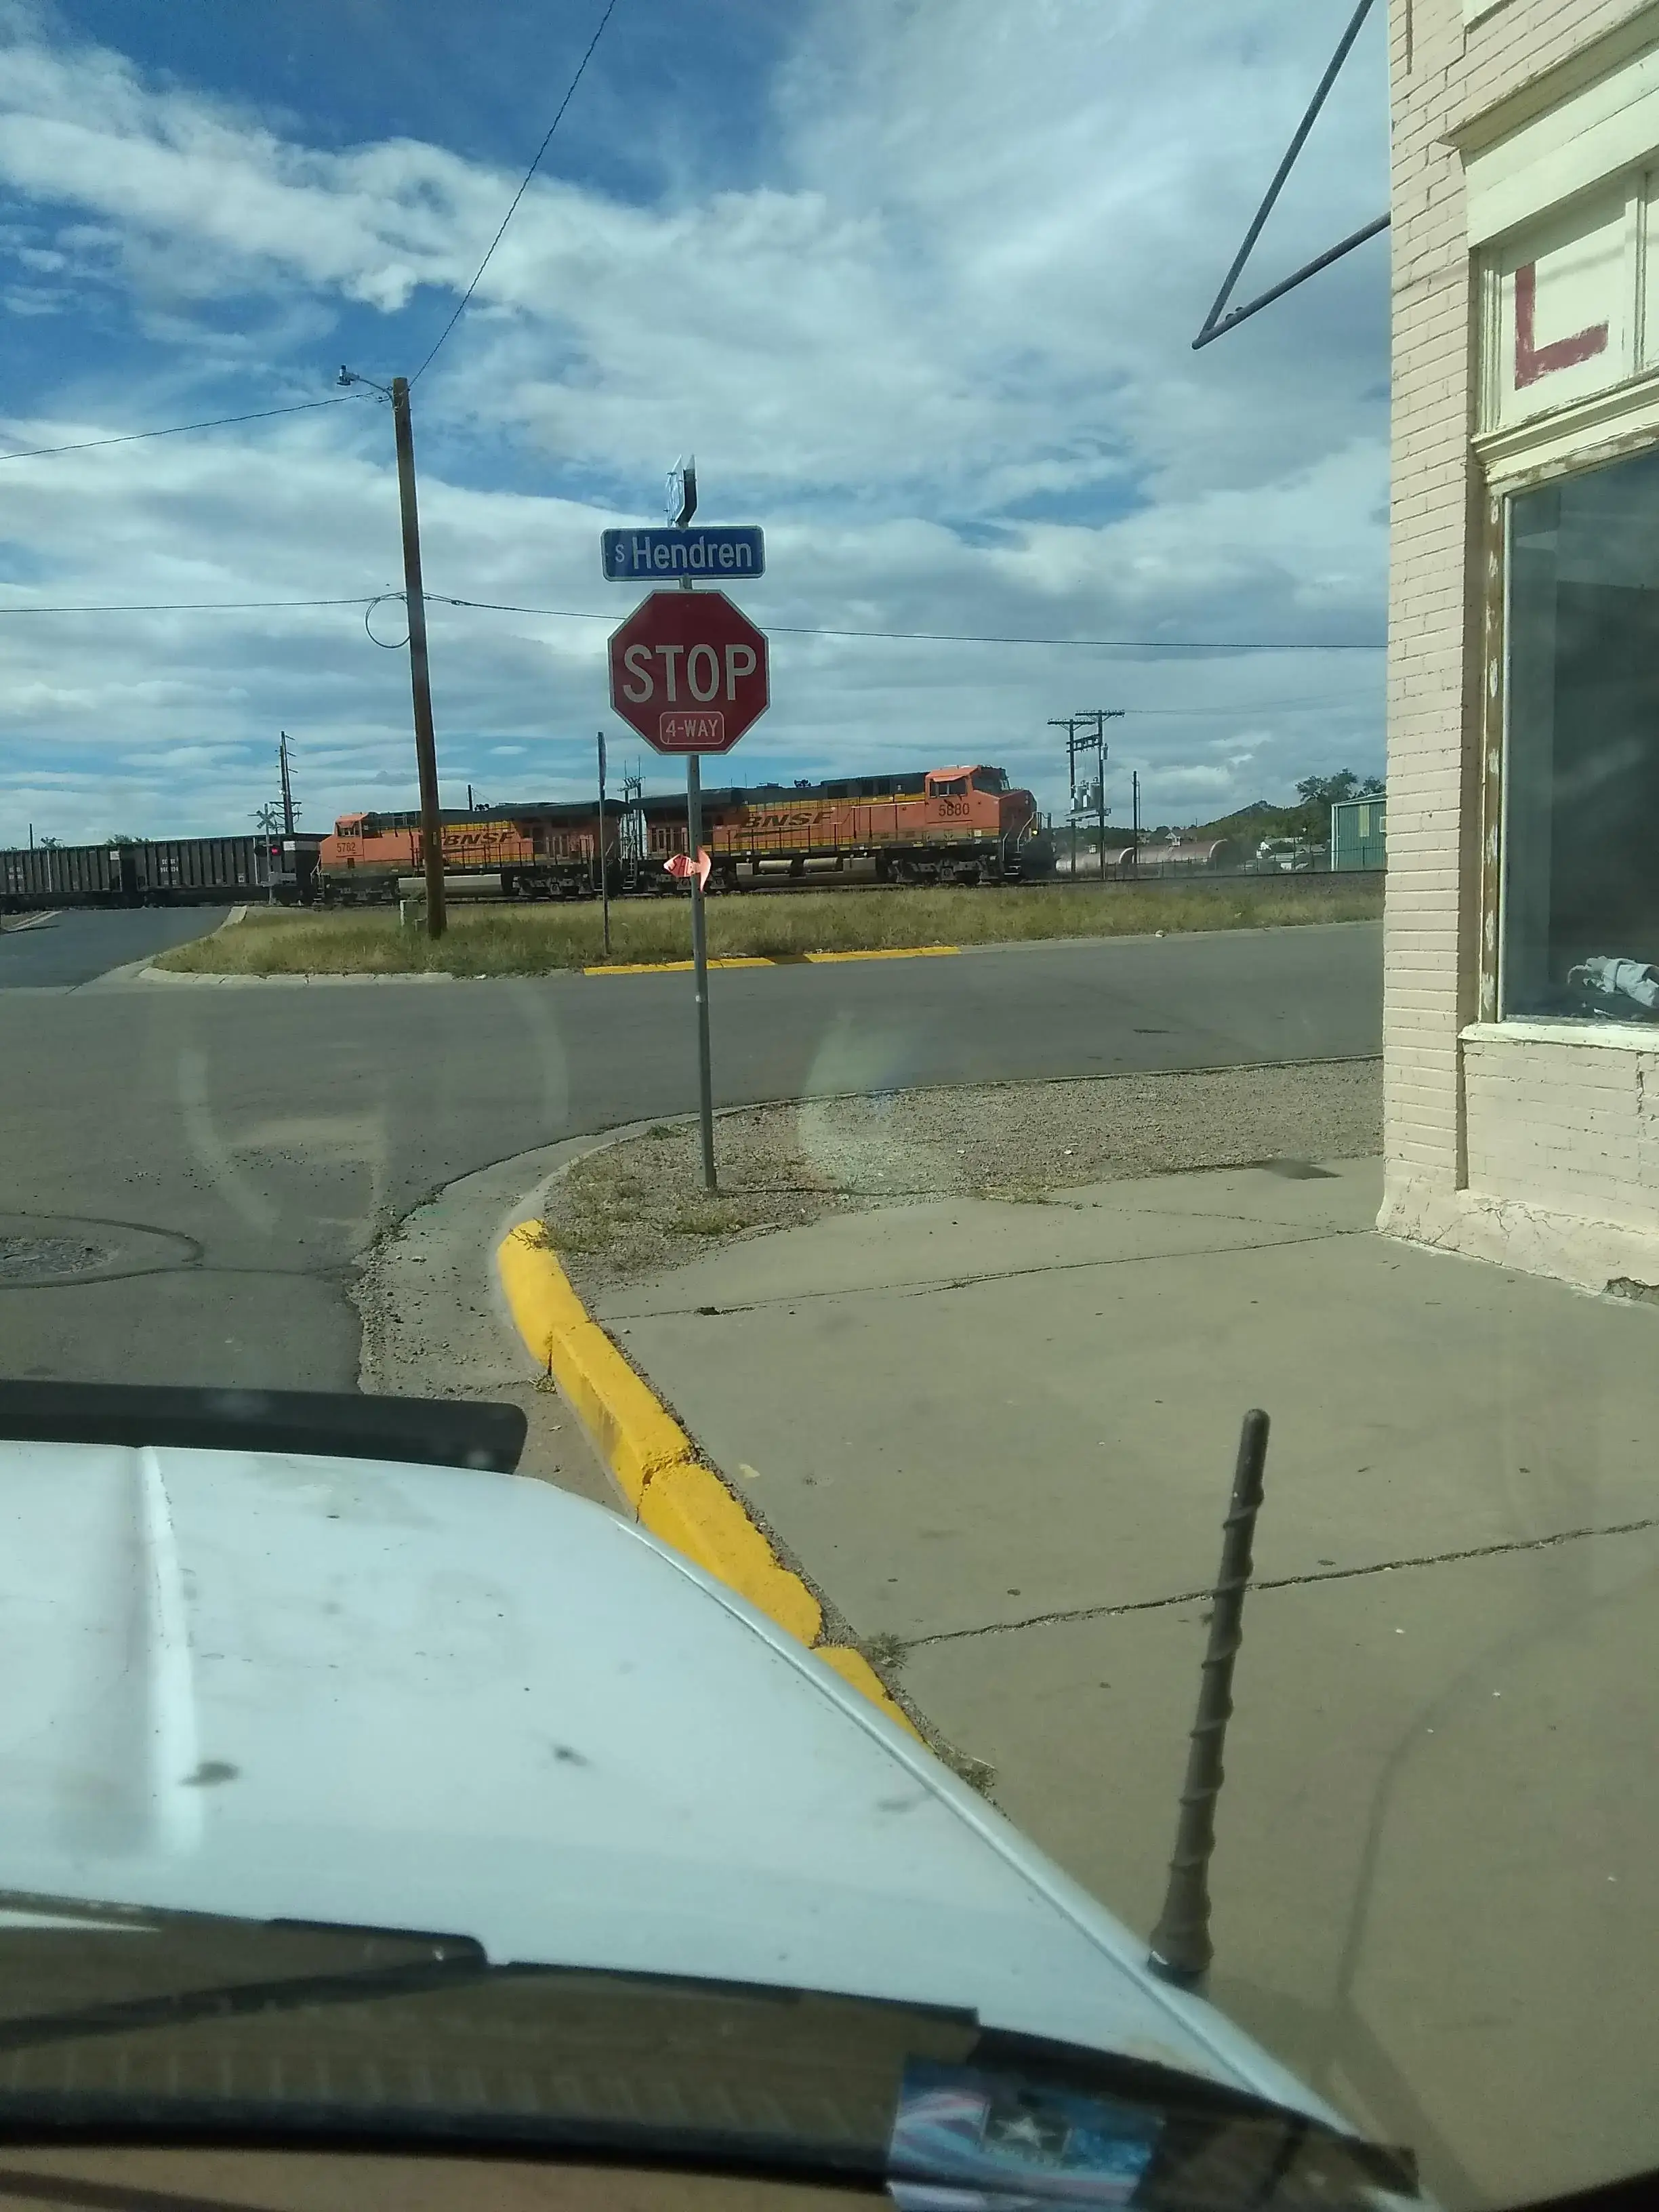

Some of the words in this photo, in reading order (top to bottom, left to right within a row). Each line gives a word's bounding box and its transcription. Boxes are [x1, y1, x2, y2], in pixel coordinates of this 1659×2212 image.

[1514, 260, 1609, 390] L
[615, 543, 624, 562] S
[632, 535, 752, 569] Hendren
[623, 644, 756, 703] STOP
[665, 719, 718, 737] 4-WAY
[741, 811, 834, 827] BNSF
[443, 832, 515, 846] BNSF
